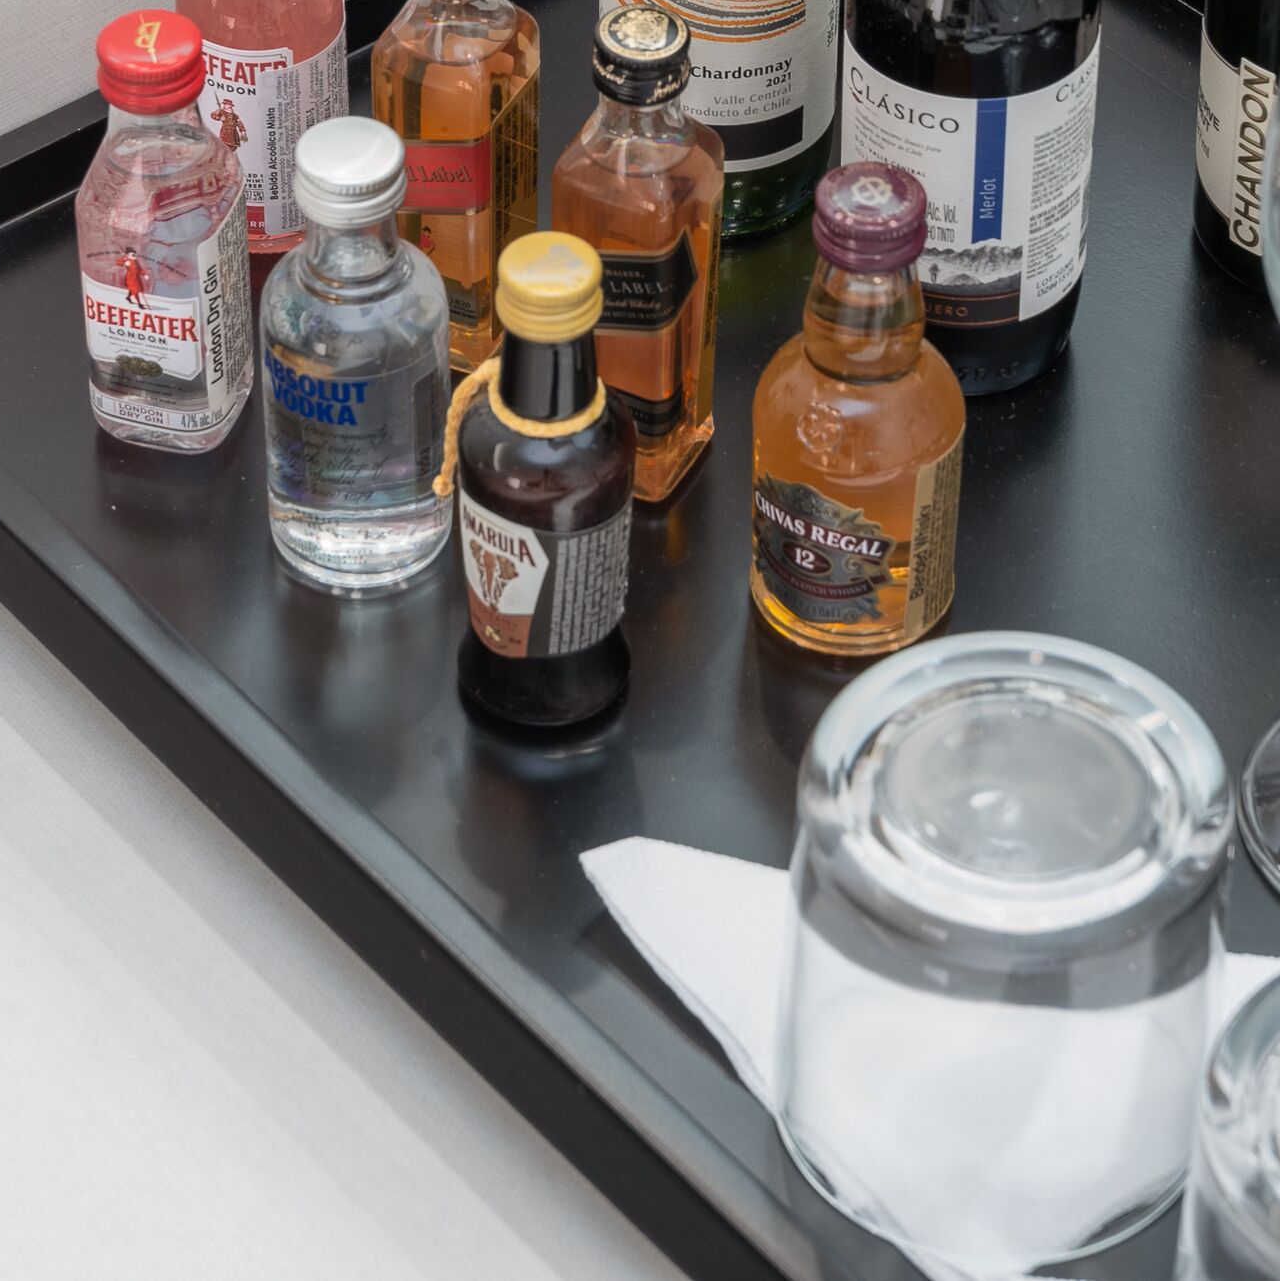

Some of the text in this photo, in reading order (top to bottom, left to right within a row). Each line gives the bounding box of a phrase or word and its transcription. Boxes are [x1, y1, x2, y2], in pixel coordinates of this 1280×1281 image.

[691, 57, 792, 80] Chardonnay
[765, 72, 792, 88] 2021
[206, 78, 257, 96] ONDON
[713, 83, 792, 105] Valle Central
[743, 105, 759, 116] de
[763, 97, 792, 112] Chile
[850, 66, 960, 134] CLÁSICO
[266, 107, 276, 130] Mista
[1233, 65, 1270, 249] CHANDON
[269, 170, 279, 200] Bebida
[979, 178, 996, 220] Merlot
[86, 294, 199, 342] BEEFEATER
[204, 264, 224, 385] London Dry Gin
[108, 327, 167, 345] LONDON
[265, 349, 368, 404] ABSOLUT
[119, 402, 164, 418] LONDON
[272, 380, 357, 426] VODKA
[119, 410, 164, 425] DRY GIN
[755, 491, 884, 558] CHIVAS REGAL
[794, 548, 816, 570] 12
